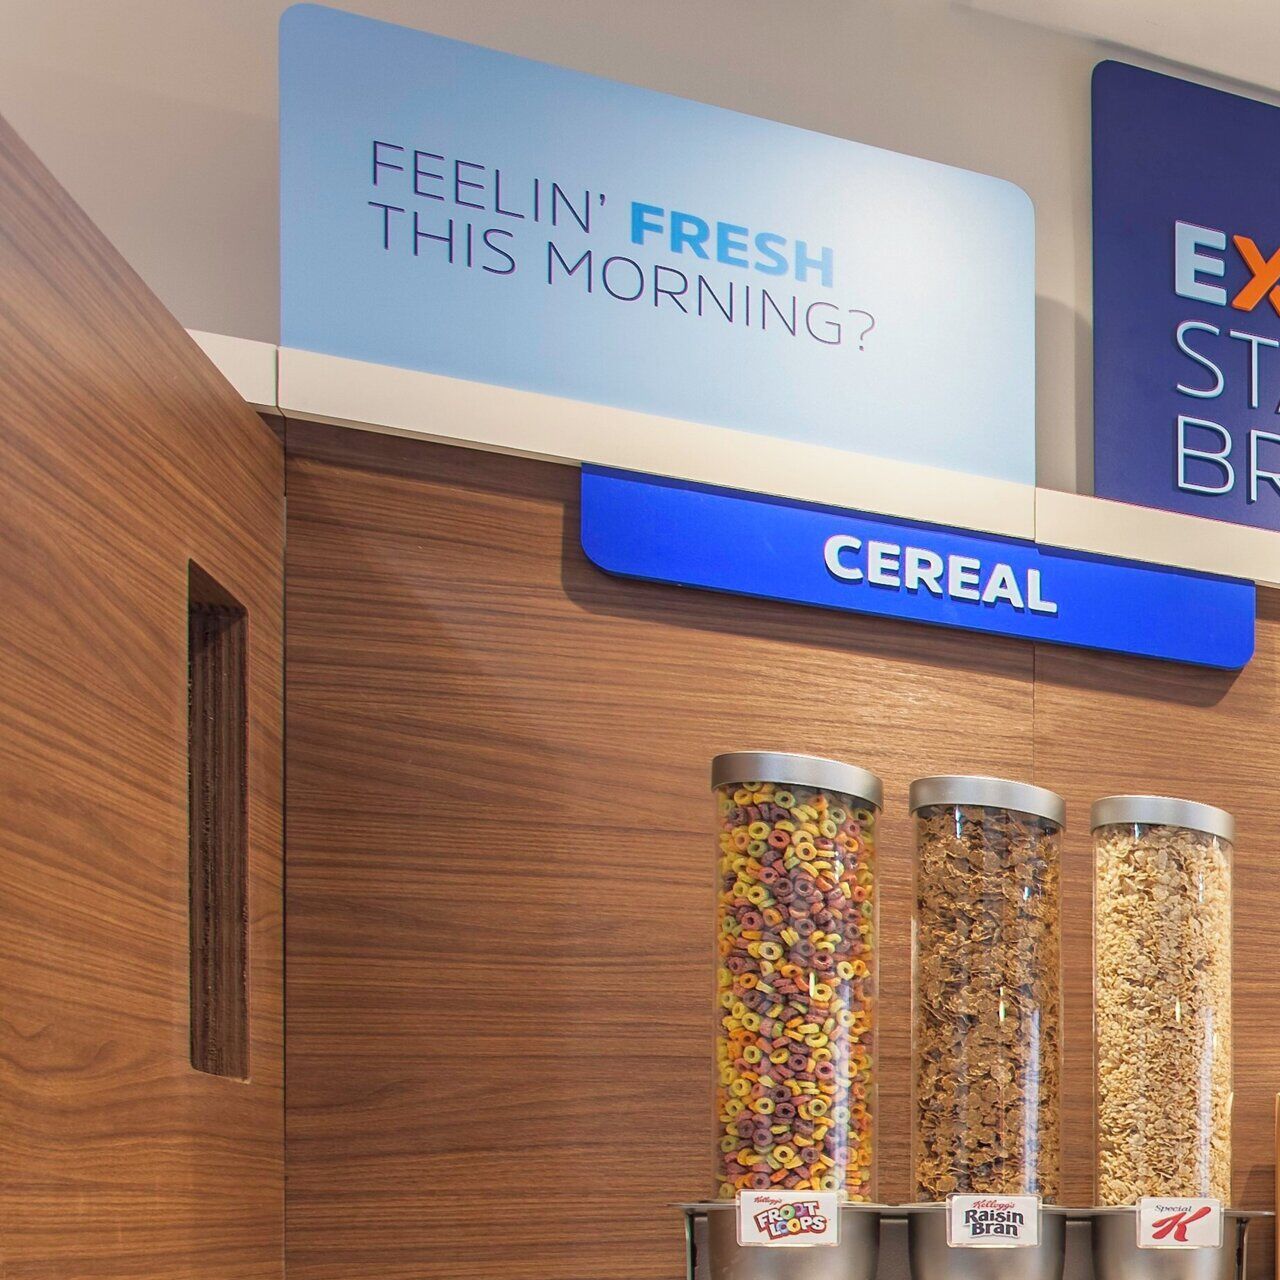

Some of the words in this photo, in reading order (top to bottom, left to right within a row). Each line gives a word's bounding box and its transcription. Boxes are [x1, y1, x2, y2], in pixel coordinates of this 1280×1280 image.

[372, 141, 607, 234] FEELIN'
[630, 201, 834, 288] FRESH
[368, 201, 517, 275] THIS
[547, 241, 877, 352] MORNING?
[824, 534, 1058, 615] CEREAL
[754, 1201, 819, 1231] FROOT
[965, 1210, 1024, 1225] Raisin
[973, 1199, 1015, 1211] Kellogg's
[1154, 1204, 1192, 1213] Special
[768, 1216, 827, 1239] LOOPS
[971, 1222, 1018, 1237] Bran
[1152, 1206, 1211, 1242] K
